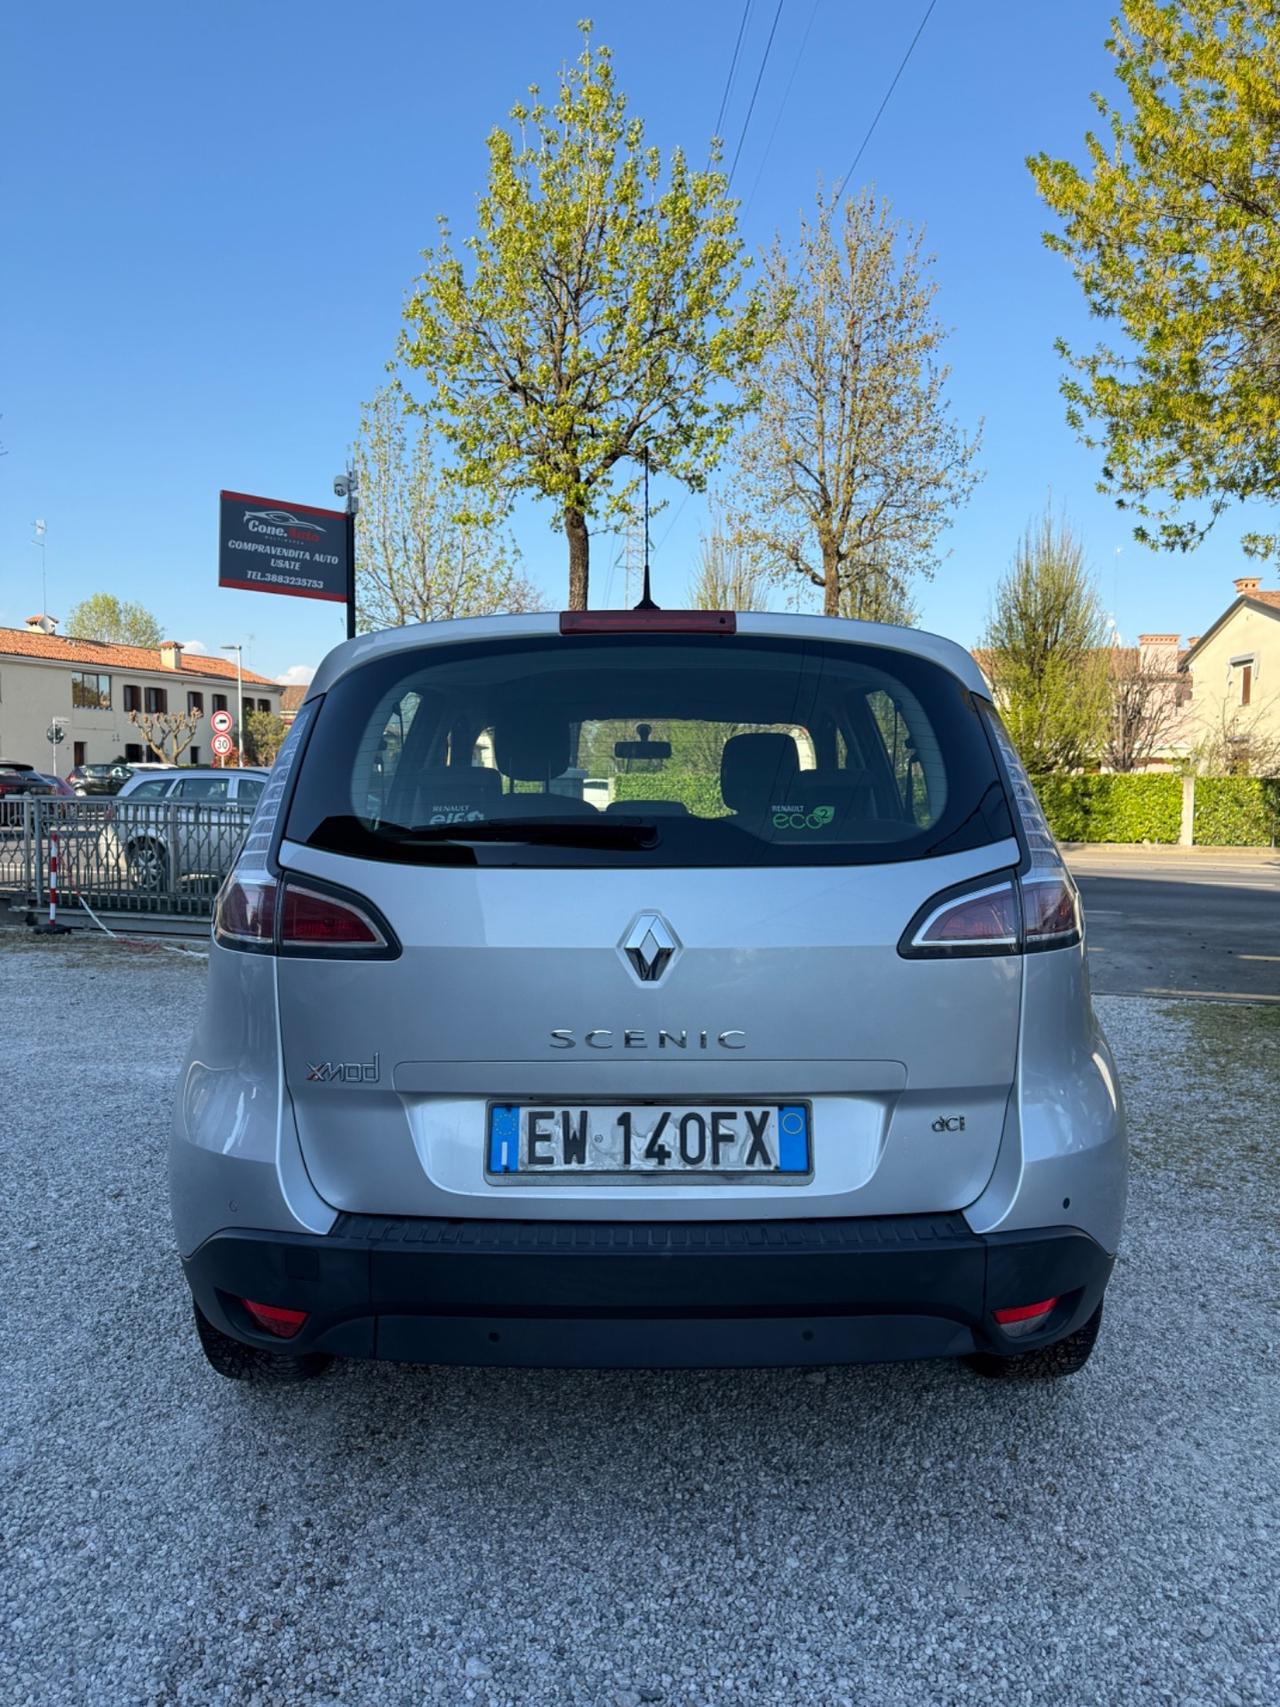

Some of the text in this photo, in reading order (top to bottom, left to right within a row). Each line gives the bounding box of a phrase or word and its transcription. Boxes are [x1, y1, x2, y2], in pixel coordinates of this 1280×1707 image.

[228, 539, 310, 560] COMPRAVENDITA
[313, 554, 339, 565] AUTO
[270, 558, 301, 571] USATE
[217, 740, 227, 749] 30
[549, 1029, 746, 1049] SCENIC
